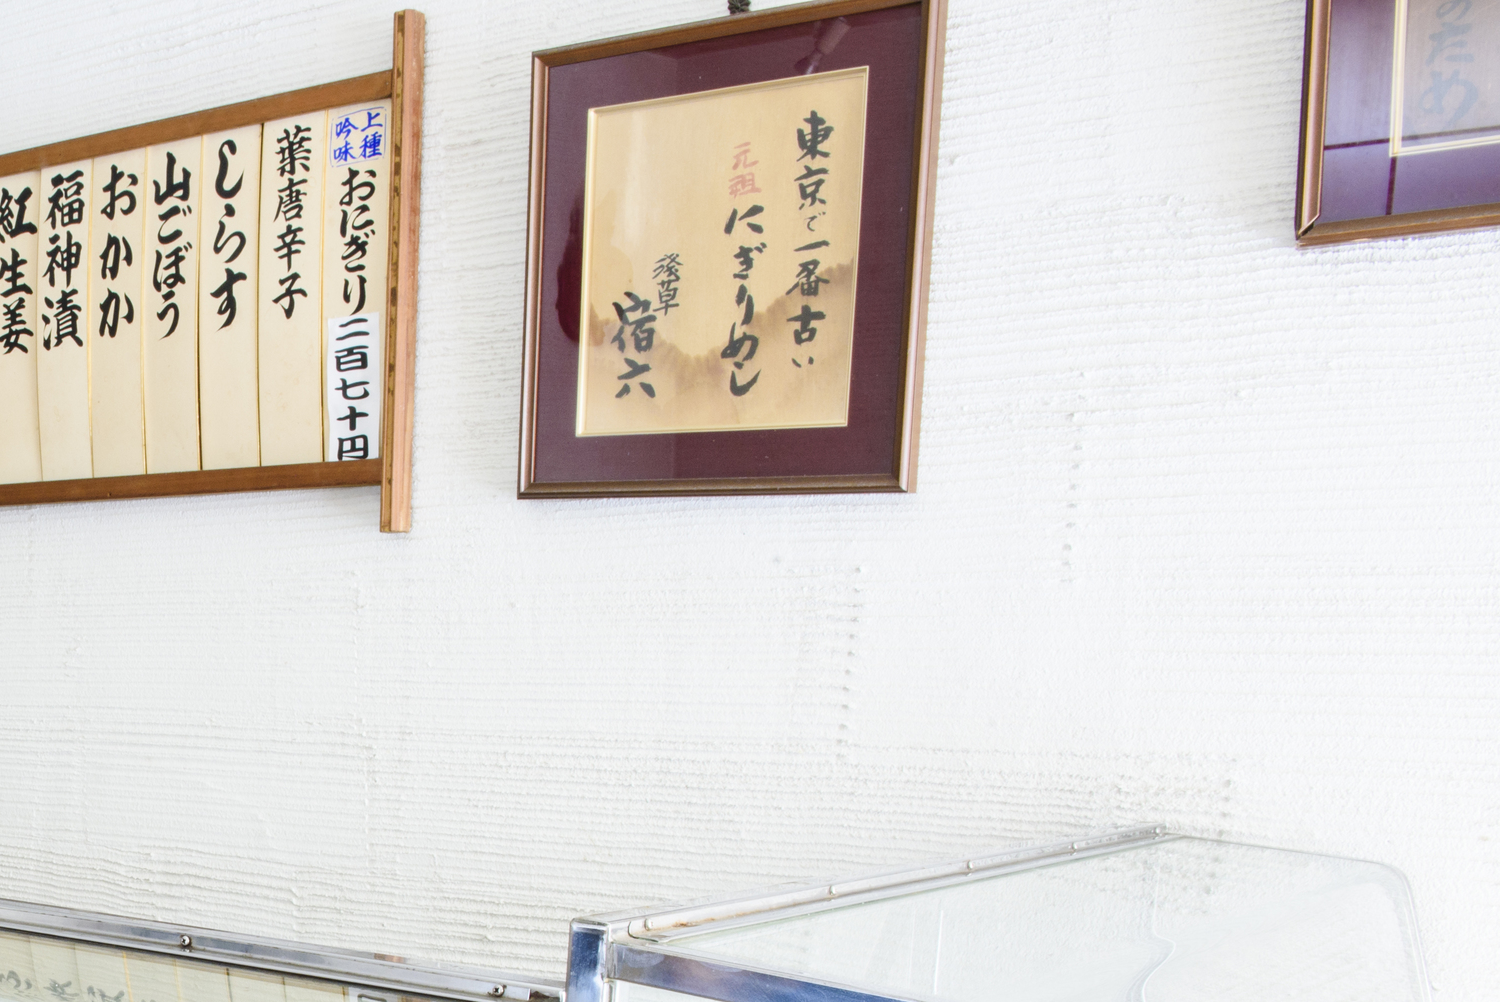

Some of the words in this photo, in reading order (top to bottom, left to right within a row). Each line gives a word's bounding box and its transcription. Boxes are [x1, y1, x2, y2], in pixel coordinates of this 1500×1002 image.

[271, 124, 313, 320] 葉唐辛子
[333, 117, 359, 162] 吟味
[359, 110, 384, 160] 上種
[42, 170, 85, 351] 福神漬
[99, 164, 139, 338] おかか
[152, 151, 194, 340] 山ごぼう
[209, 138, 248, 333] しらす
[338, 167, 377, 316] おにぎり
[720, 204, 767, 398] にぎりめし
[785, 109, 835, 369] 東京で一番古い
[334, 317, 371, 460] 二百七十円
[611, 290, 657, 399] 宿六
